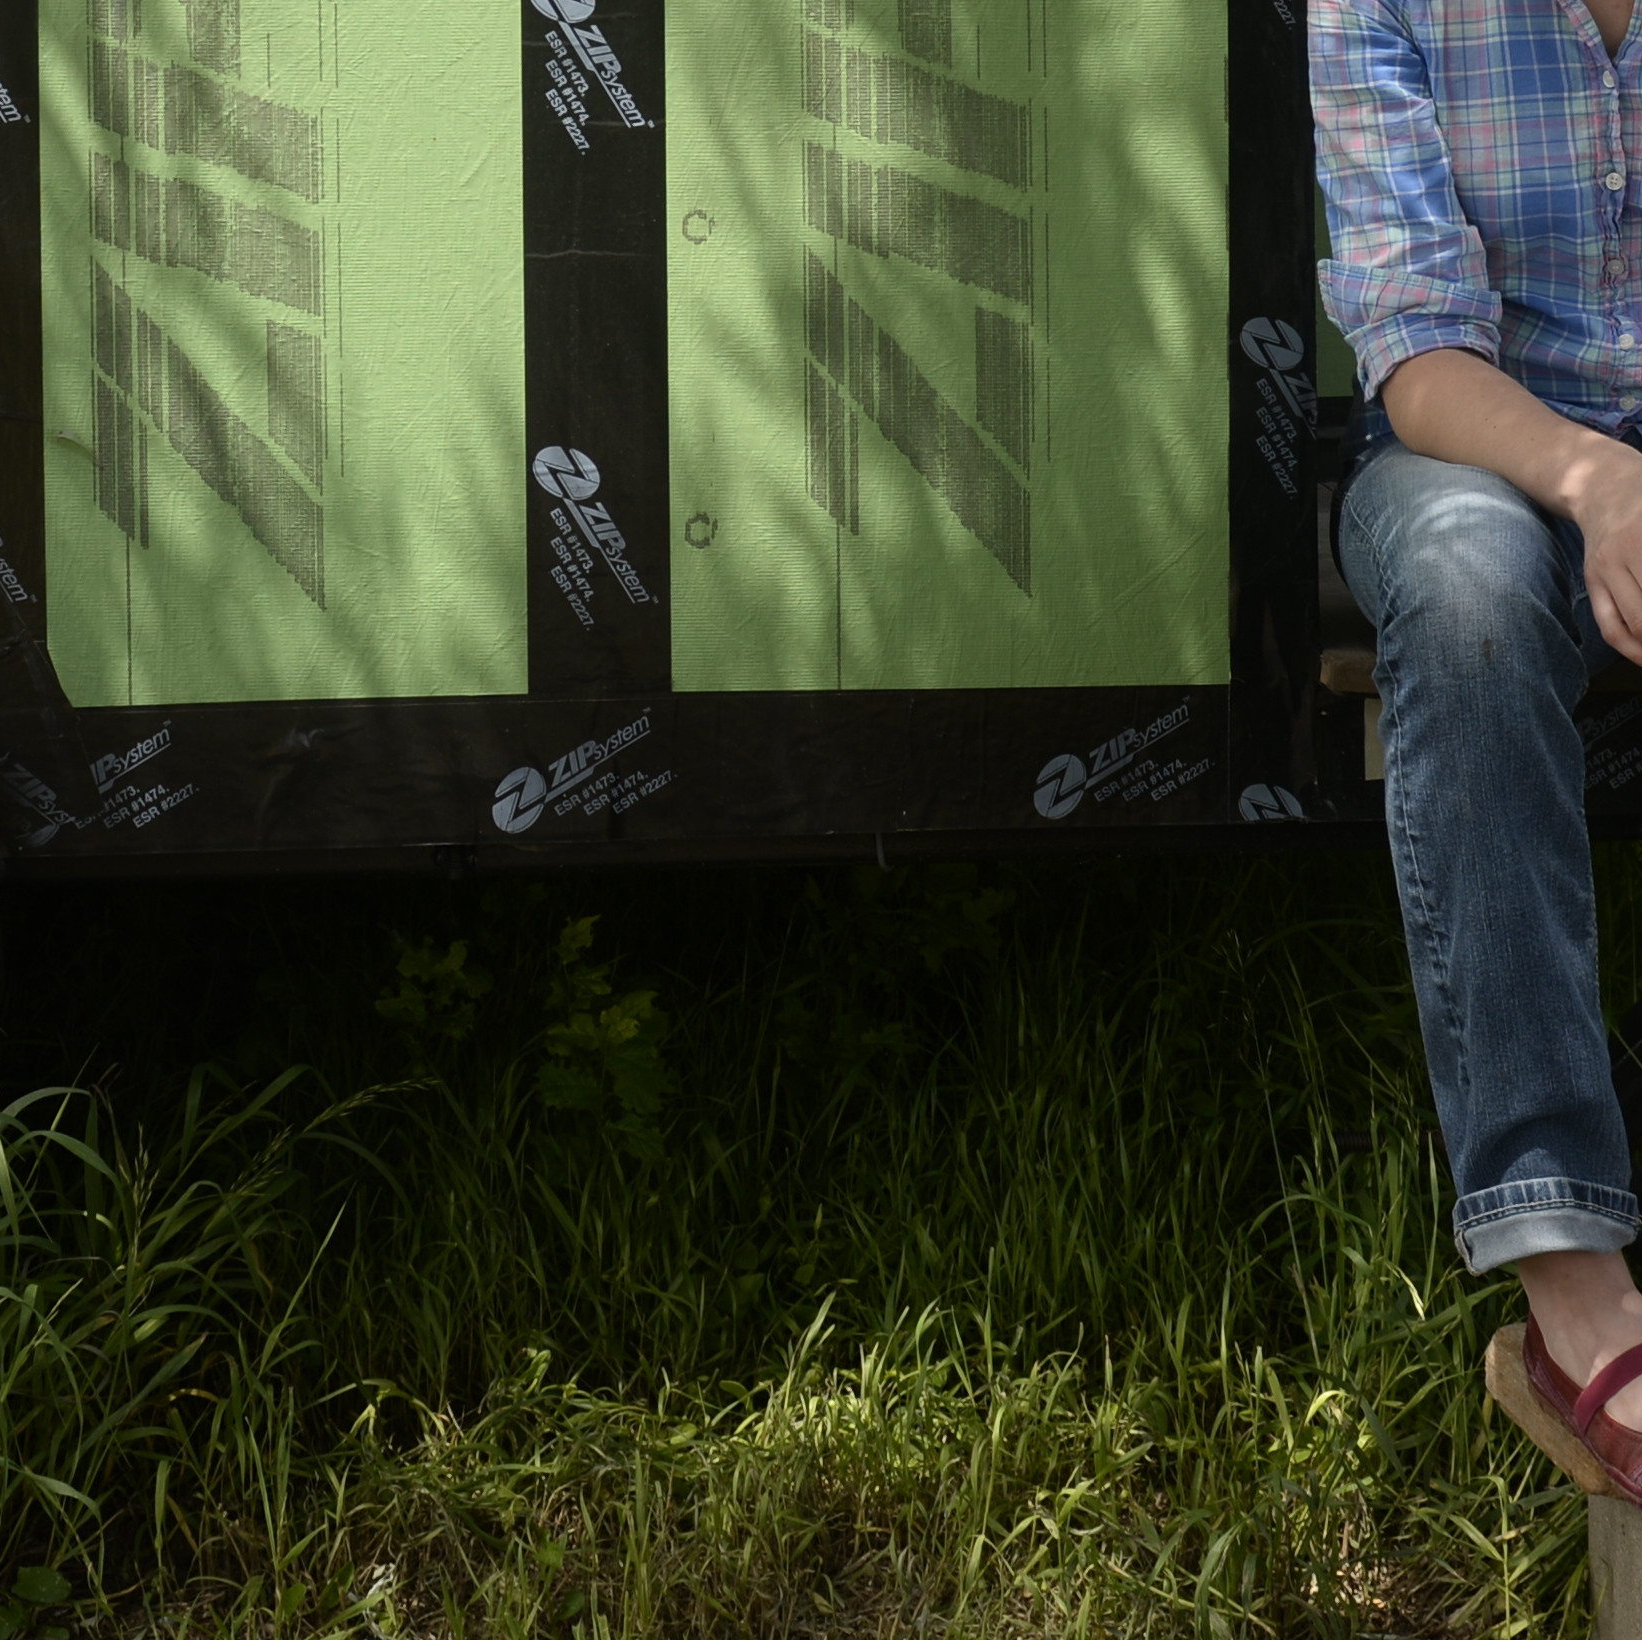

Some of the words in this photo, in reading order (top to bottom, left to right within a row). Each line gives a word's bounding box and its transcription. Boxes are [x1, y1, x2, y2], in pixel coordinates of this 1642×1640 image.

[544, 30, 567, 59] ESR
[562, 57, 589, 98] #1473.
[544, 60, 567, 88] ESR
[562, 86, 590, 127] #1474.
[544, 88, 567, 118] ESR
[562, 116, 591, 156] #2227.
